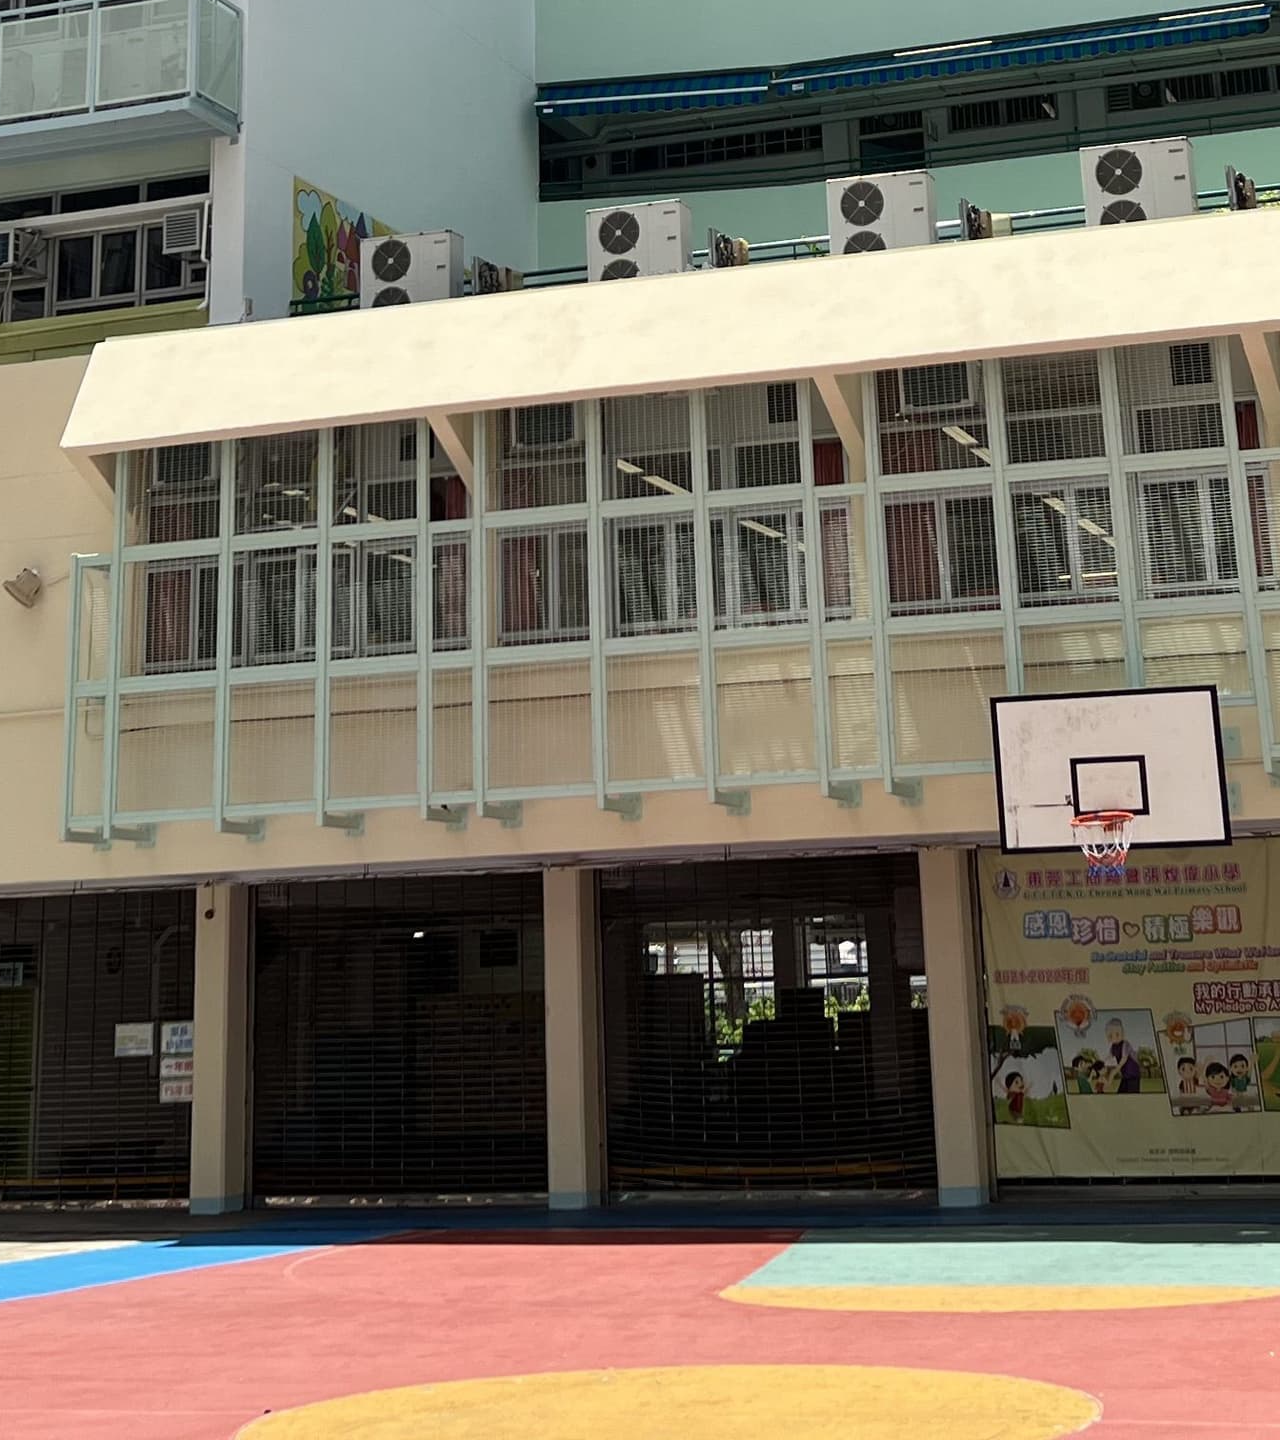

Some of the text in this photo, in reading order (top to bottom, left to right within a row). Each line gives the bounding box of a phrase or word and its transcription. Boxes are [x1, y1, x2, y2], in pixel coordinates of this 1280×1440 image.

[1023, 906, 1241, 945] 感恩珍惜 積極樂觀
[1195, 1000, 1213, 1014] My
[1215, 999, 1253, 1014] Pledge
[1254, 1000, 1267, 1012] to
